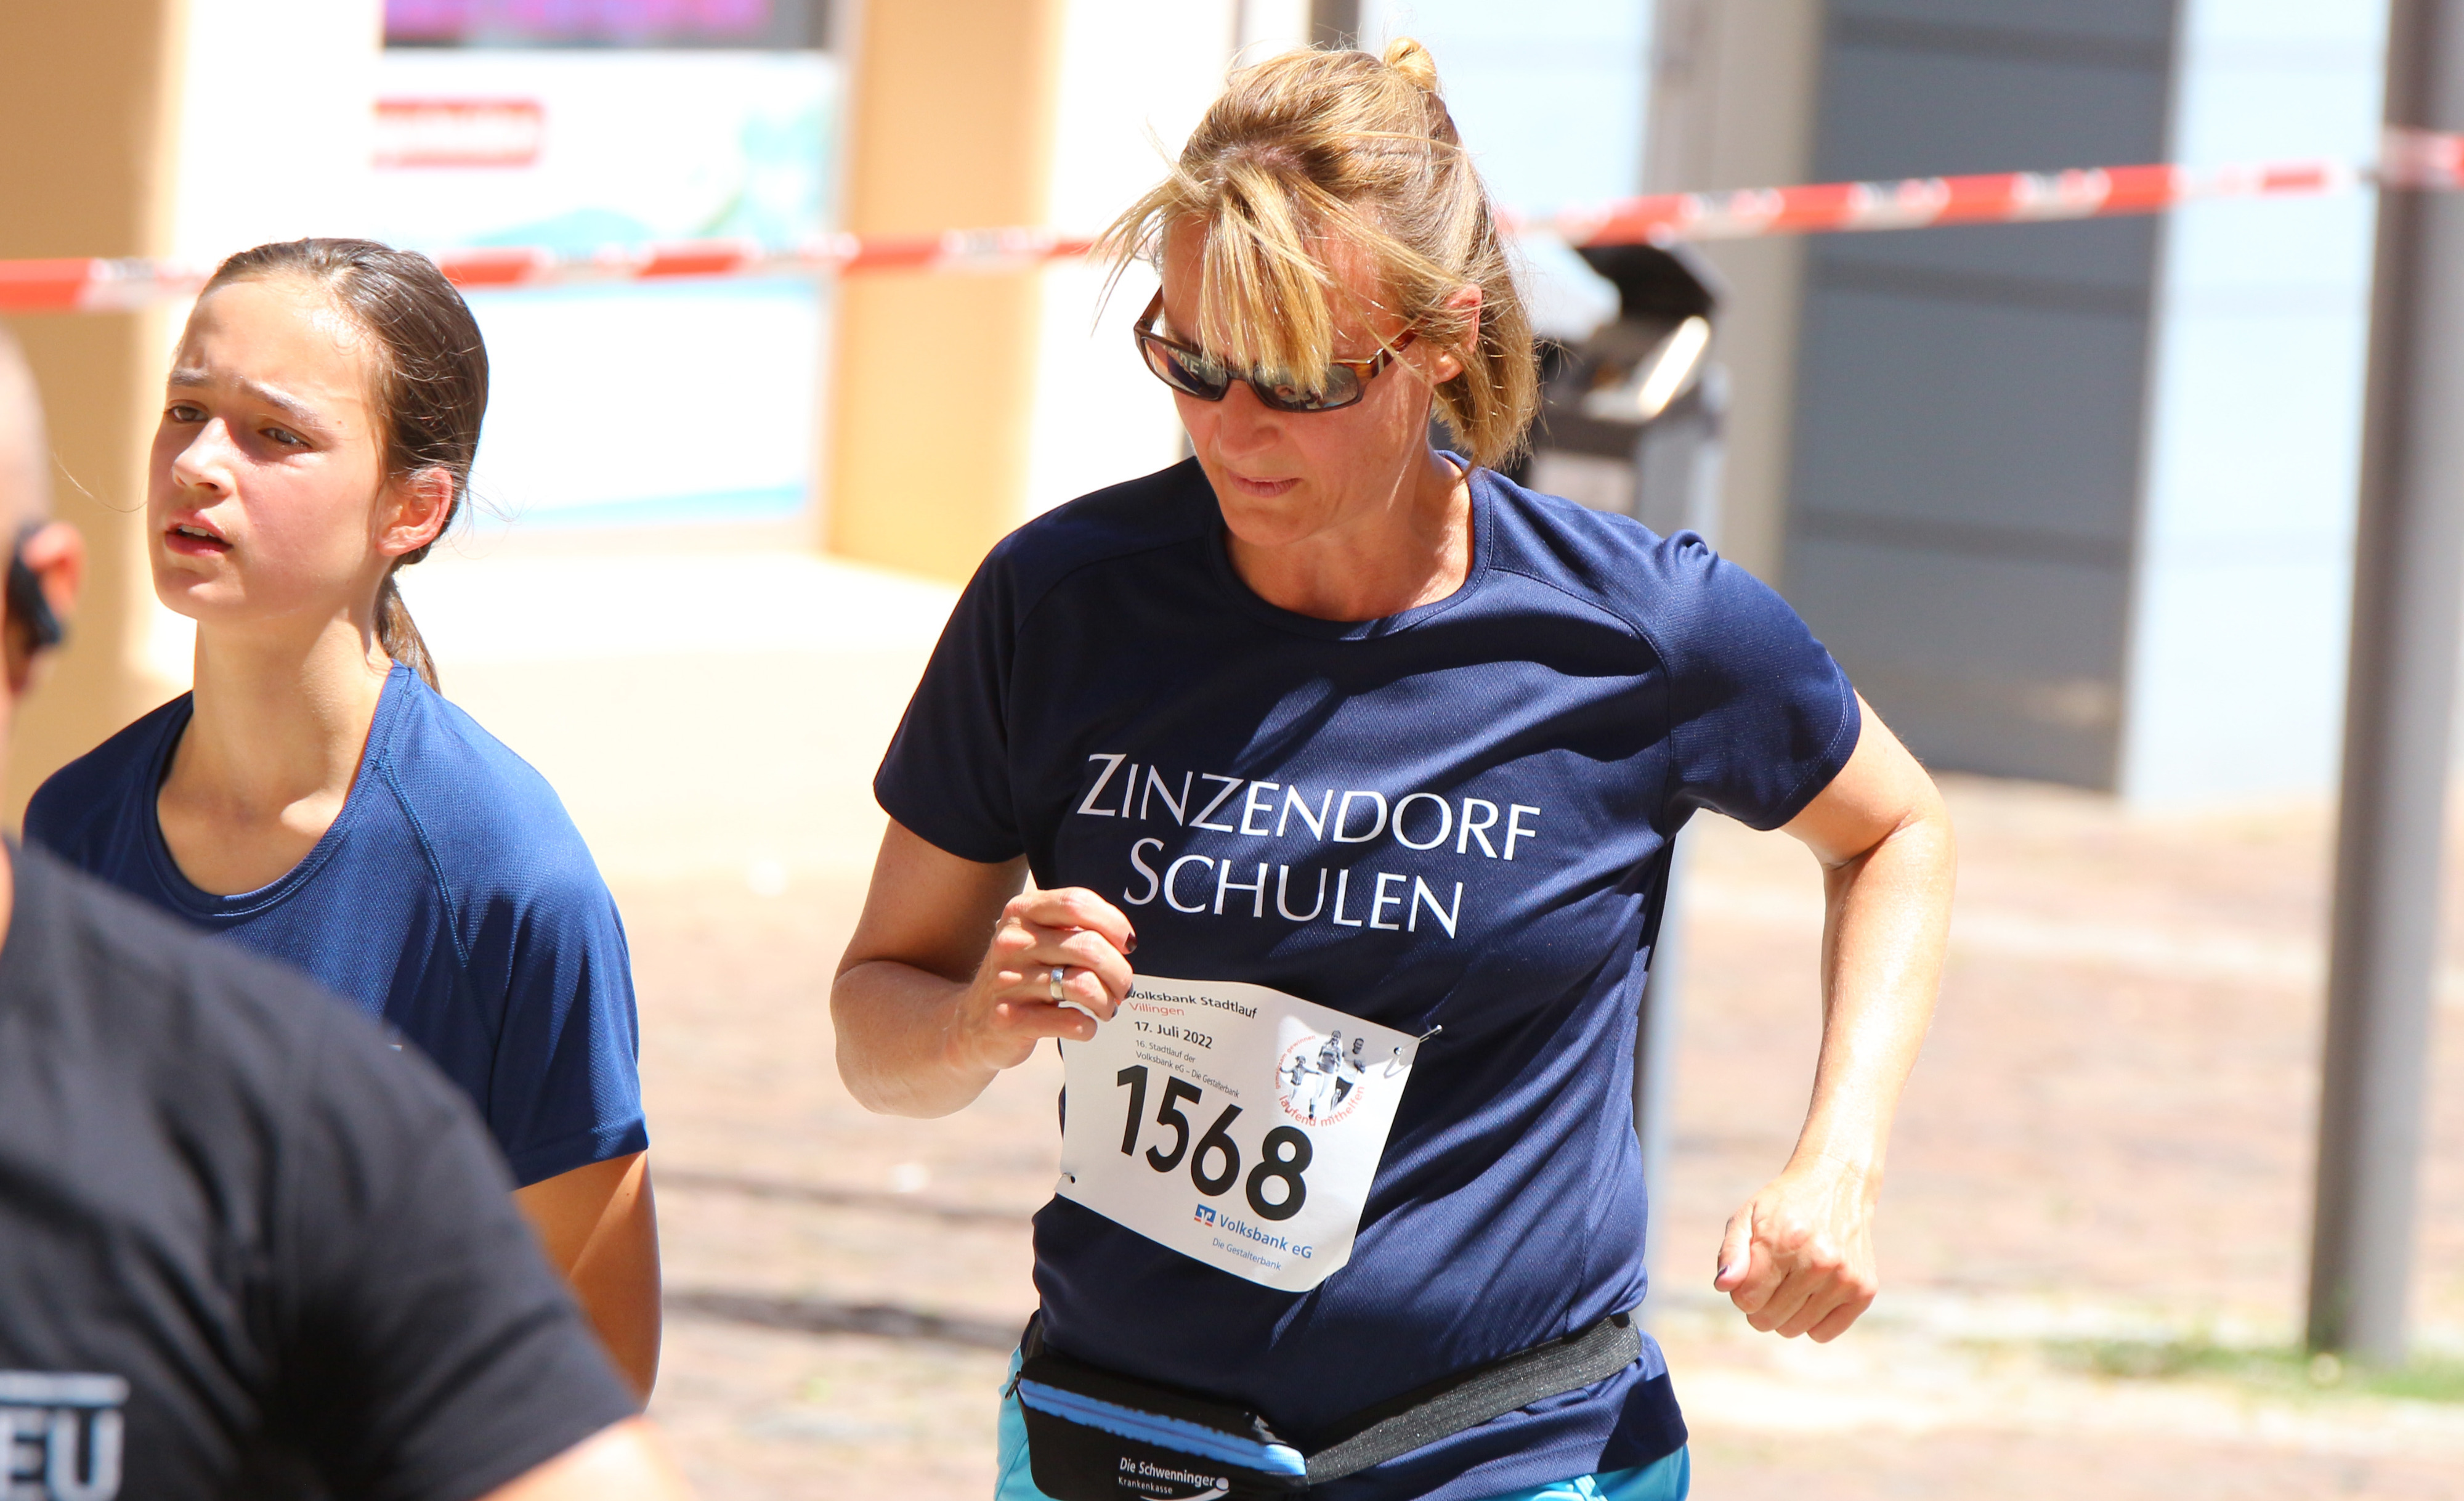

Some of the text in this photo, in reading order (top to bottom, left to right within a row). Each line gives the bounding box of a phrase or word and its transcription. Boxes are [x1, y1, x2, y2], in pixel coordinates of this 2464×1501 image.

[1077, 753, 1541, 861] ZINZENDORF
[1123, 837, 1463, 940] SCHULEN
[1129, 1002, 1185, 1016] Villingen
[1201, 996, 1258, 1019] Stadtlauf
[1134, 1021, 1213, 1049] 17. Juli 2022
[1135, 1039, 1196, 1063] 16. Stadtlauf der
[1135, 1051, 1173, 1068] Volksbank
[1175, 1064, 1184, 1073] eG
[1191, 1068, 1202, 1080] Die
[1202, 1075, 1240, 1099] Gestalterbank
[1279, 1086, 1365, 1127] laufend mithelfen
[1116, 1064, 1313, 1221] 1568
[1220, 1214, 1313, 1259] Volksbank eG
[1212, 1237, 1281, 1271] Die Gestalterbank
[1118, 1476, 1173, 1494] Krankenkasse
[1119, 1457, 1215, 1487] Die Schwenninger
